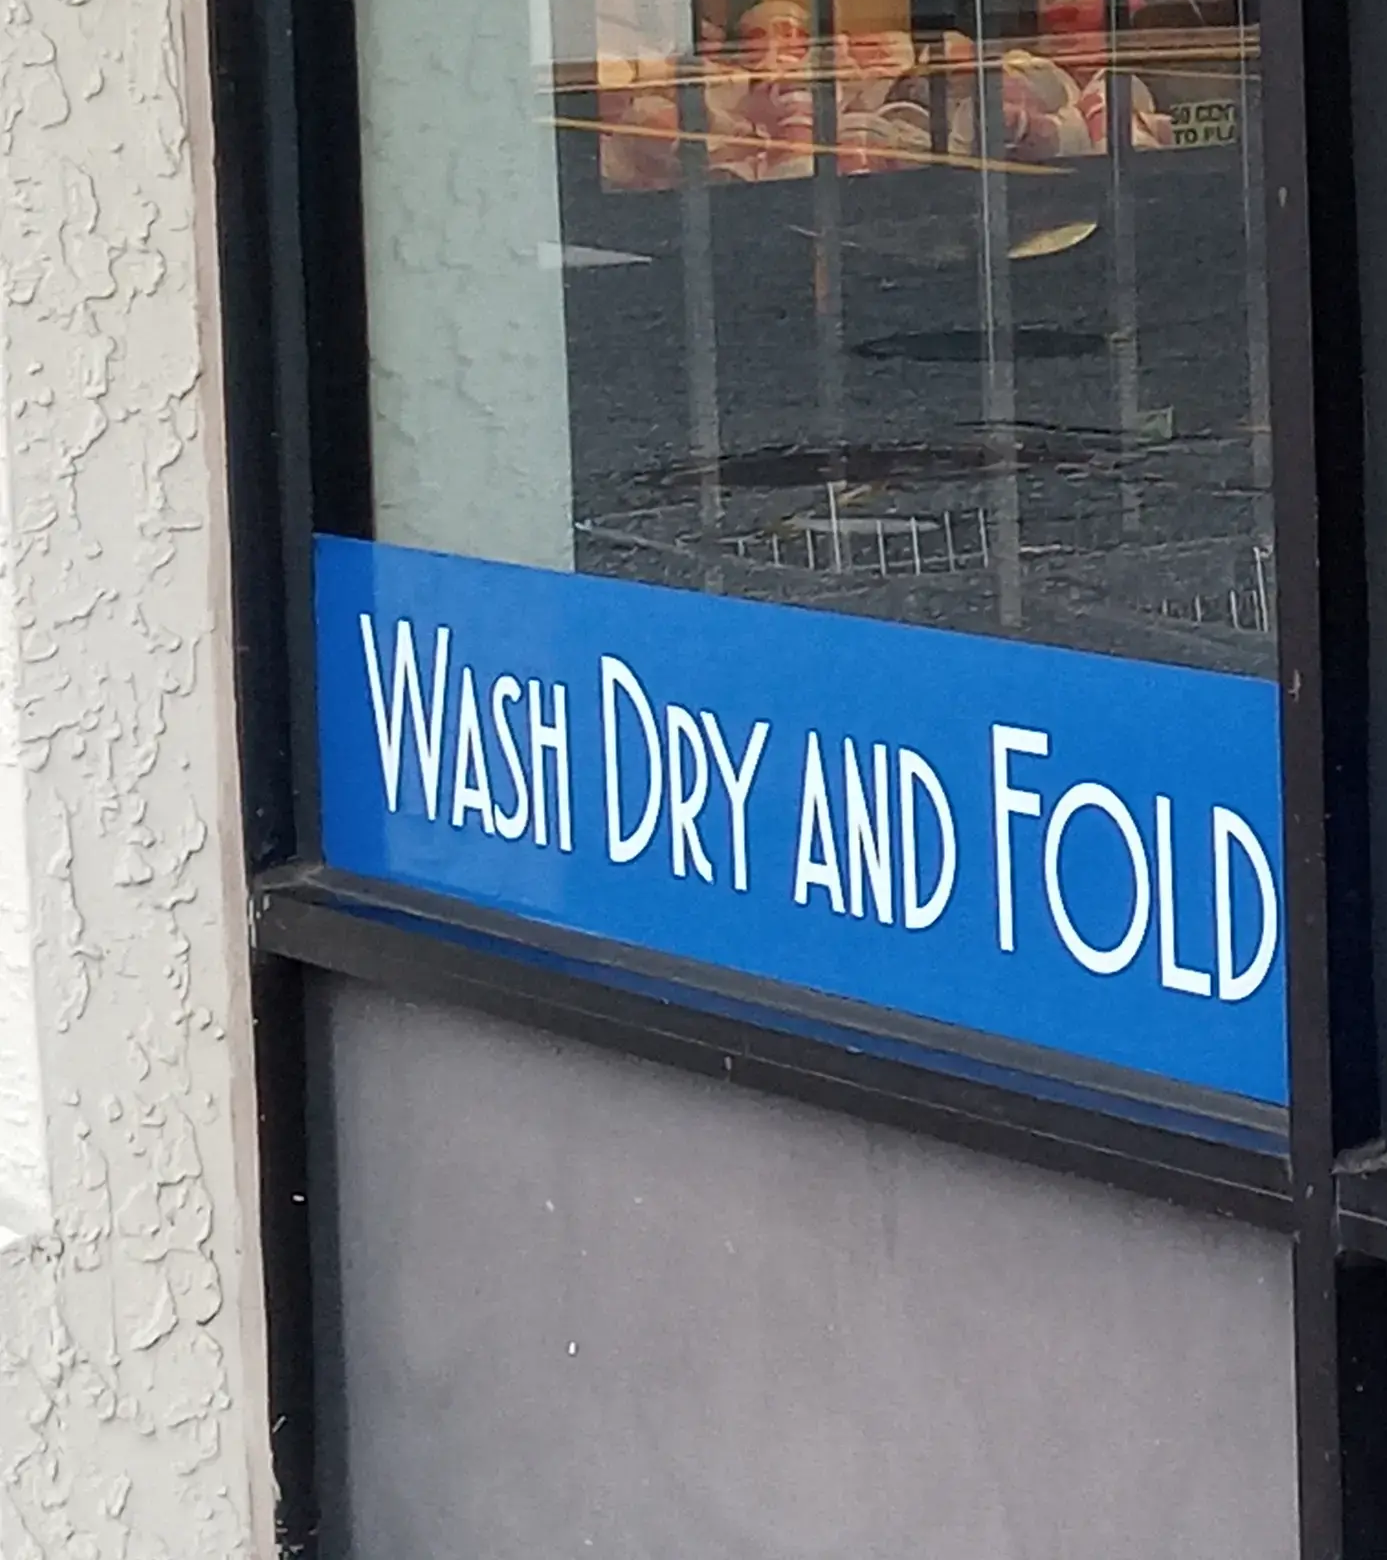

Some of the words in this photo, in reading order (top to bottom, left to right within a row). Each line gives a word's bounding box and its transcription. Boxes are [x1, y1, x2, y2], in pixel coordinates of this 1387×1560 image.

[1172, 127, 1198, 145] TO
[358, 613, 573, 853] WASH
[600, 655, 770, 892] DRY
[793, 729, 957, 930] AND
[990, 723, 1279, 1002] FOLD
